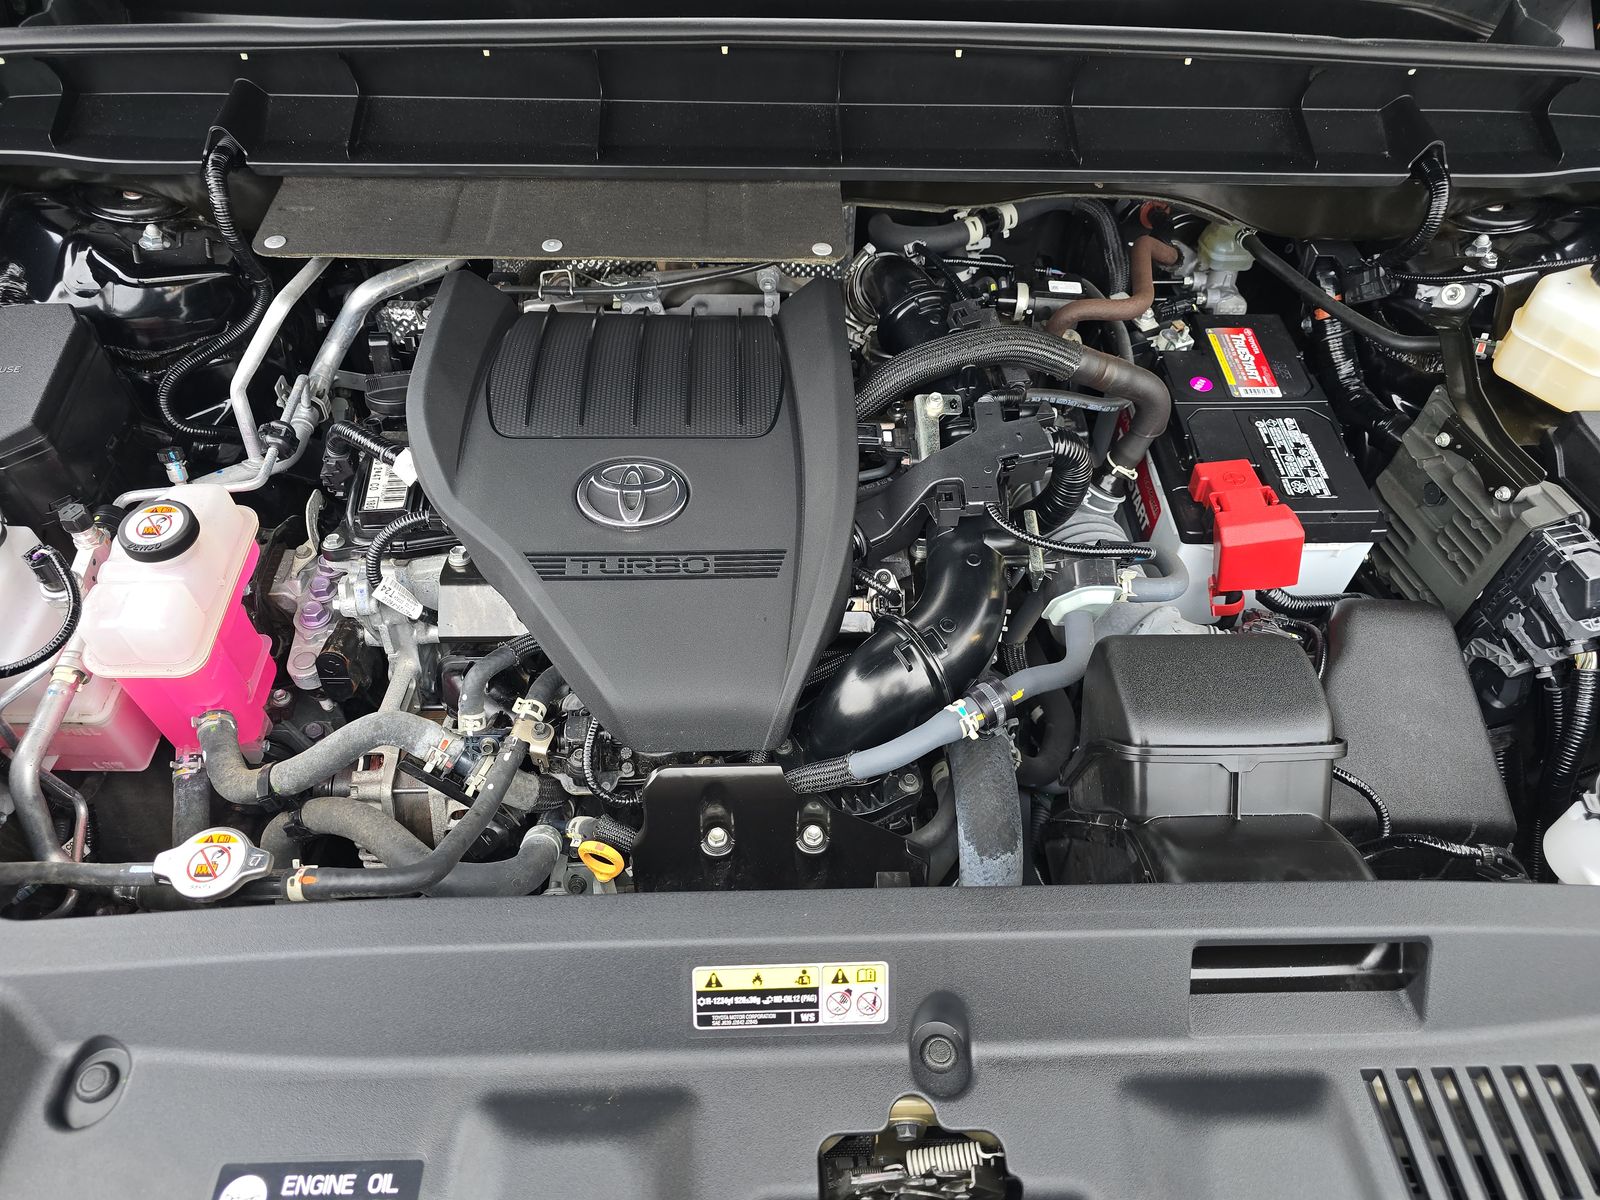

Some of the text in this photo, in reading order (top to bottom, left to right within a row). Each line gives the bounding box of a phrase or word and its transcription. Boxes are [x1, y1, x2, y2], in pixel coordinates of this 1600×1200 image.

[1247, 335, 1260, 354] TOYOTA
[127, 543, 162, 552] DENSO
[570, 556, 711, 575] TURBO
[800, 1013, 816, 1022] WS
[281, 1173, 399, 1196] ENGINE OIL
